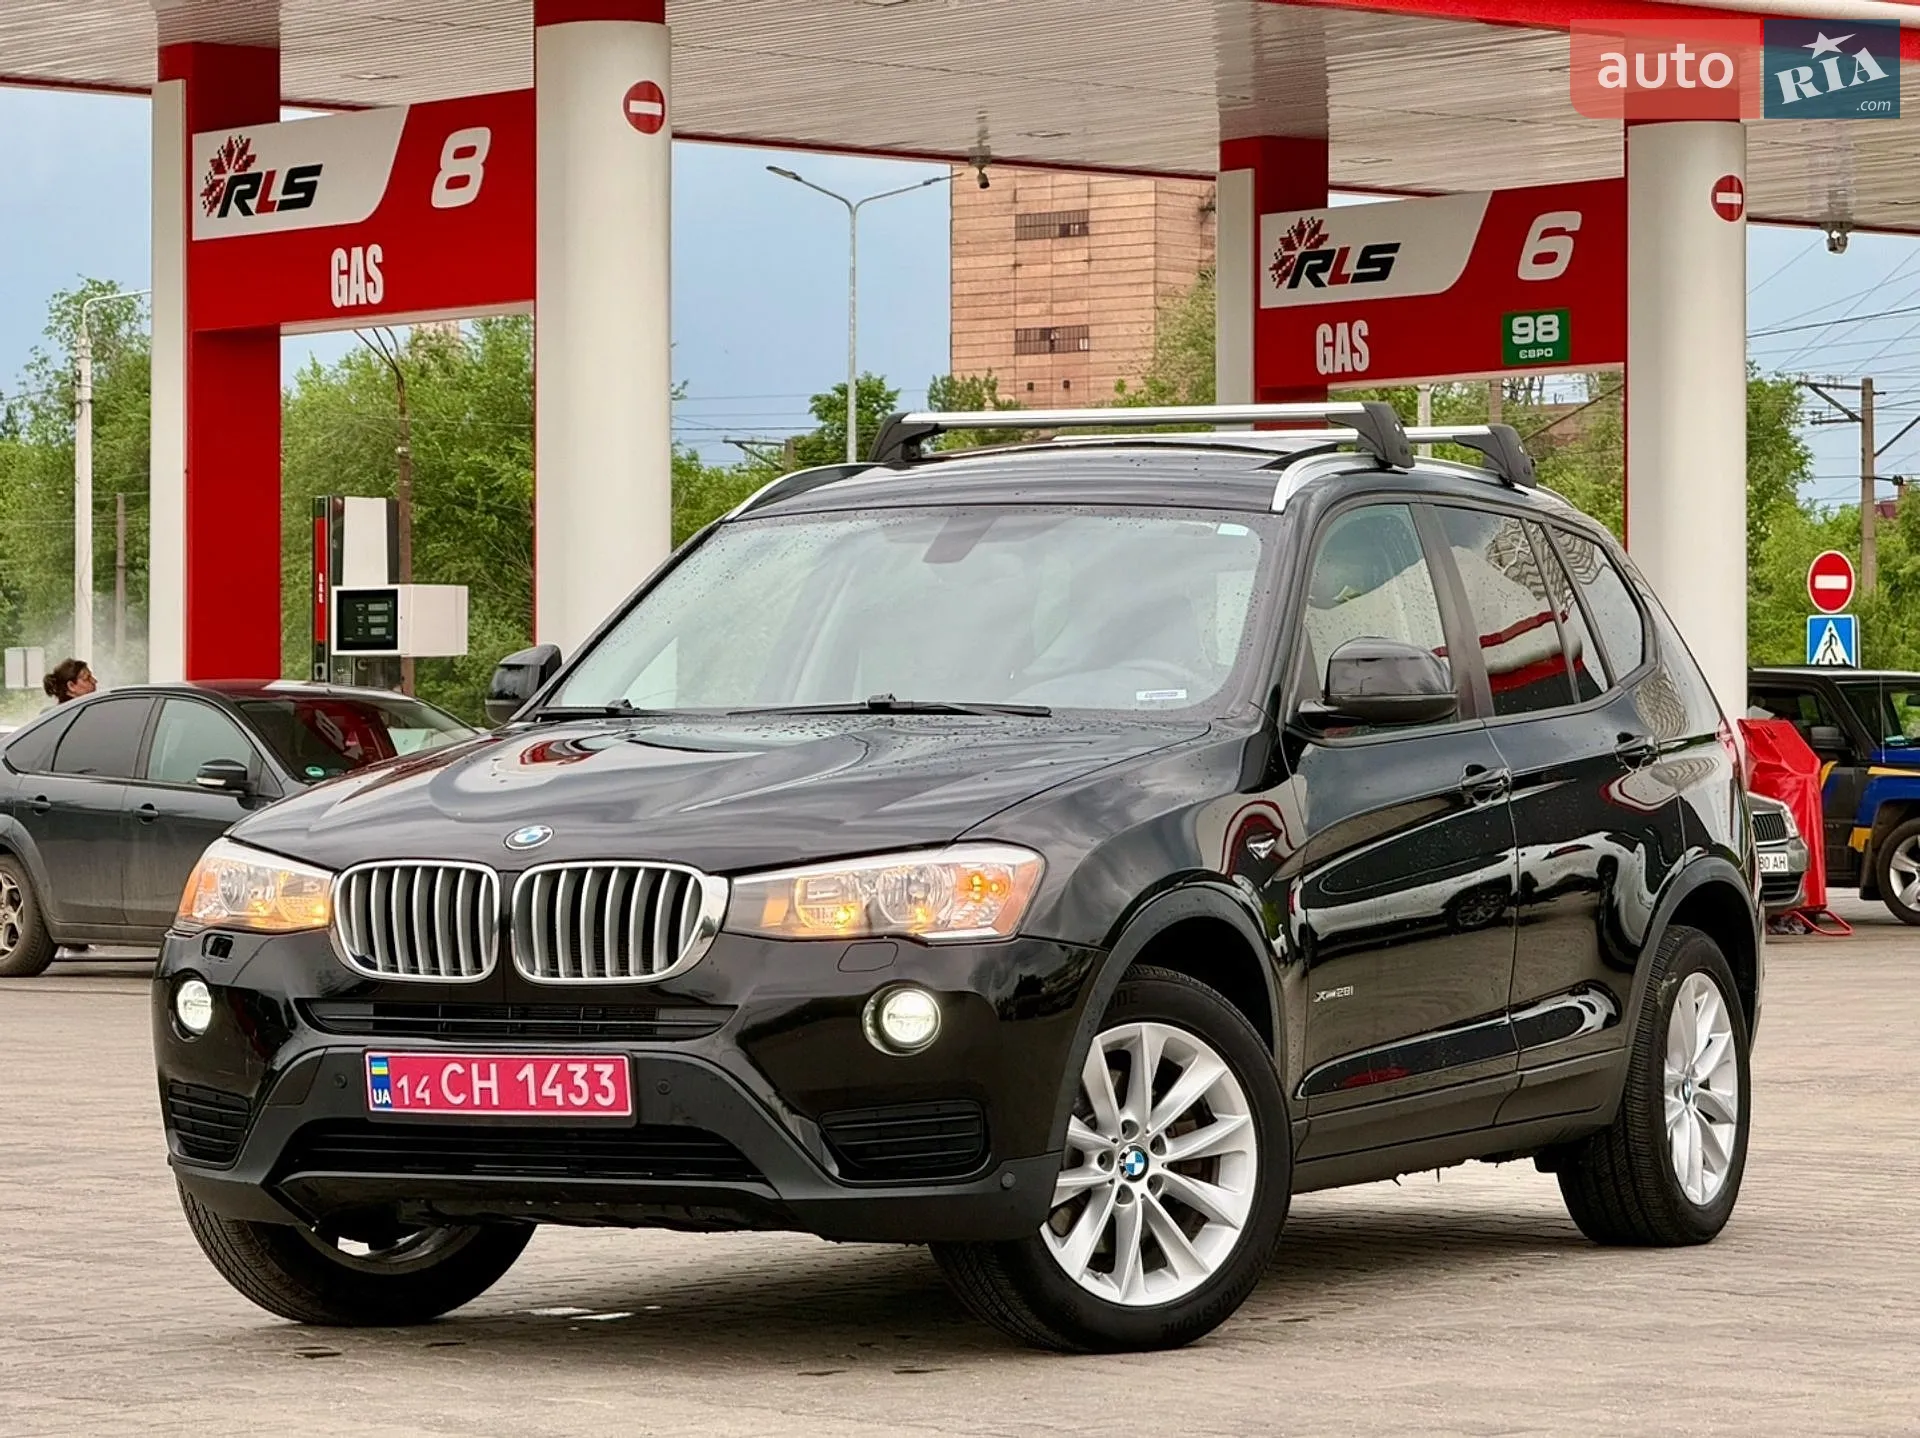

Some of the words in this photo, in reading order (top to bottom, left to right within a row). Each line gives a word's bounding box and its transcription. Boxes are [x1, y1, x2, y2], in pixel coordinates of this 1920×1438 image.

[217, 163, 324, 219] RLS
[431, 126, 492, 209] 8
[1287, 242, 1402, 289] RLS
[1517, 210, 1583, 281] 6
[330, 243, 385, 308] GAS
[1315, 319, 1370, 375] GAS
[1511, 314, 1560, 344] 98
[373, 1088, 392, 1104] UA
[396, 1074, 432, 1106] 14
[440, 1062, 499, 1105] CH
[516, 1063, 616, 1106] 1433
